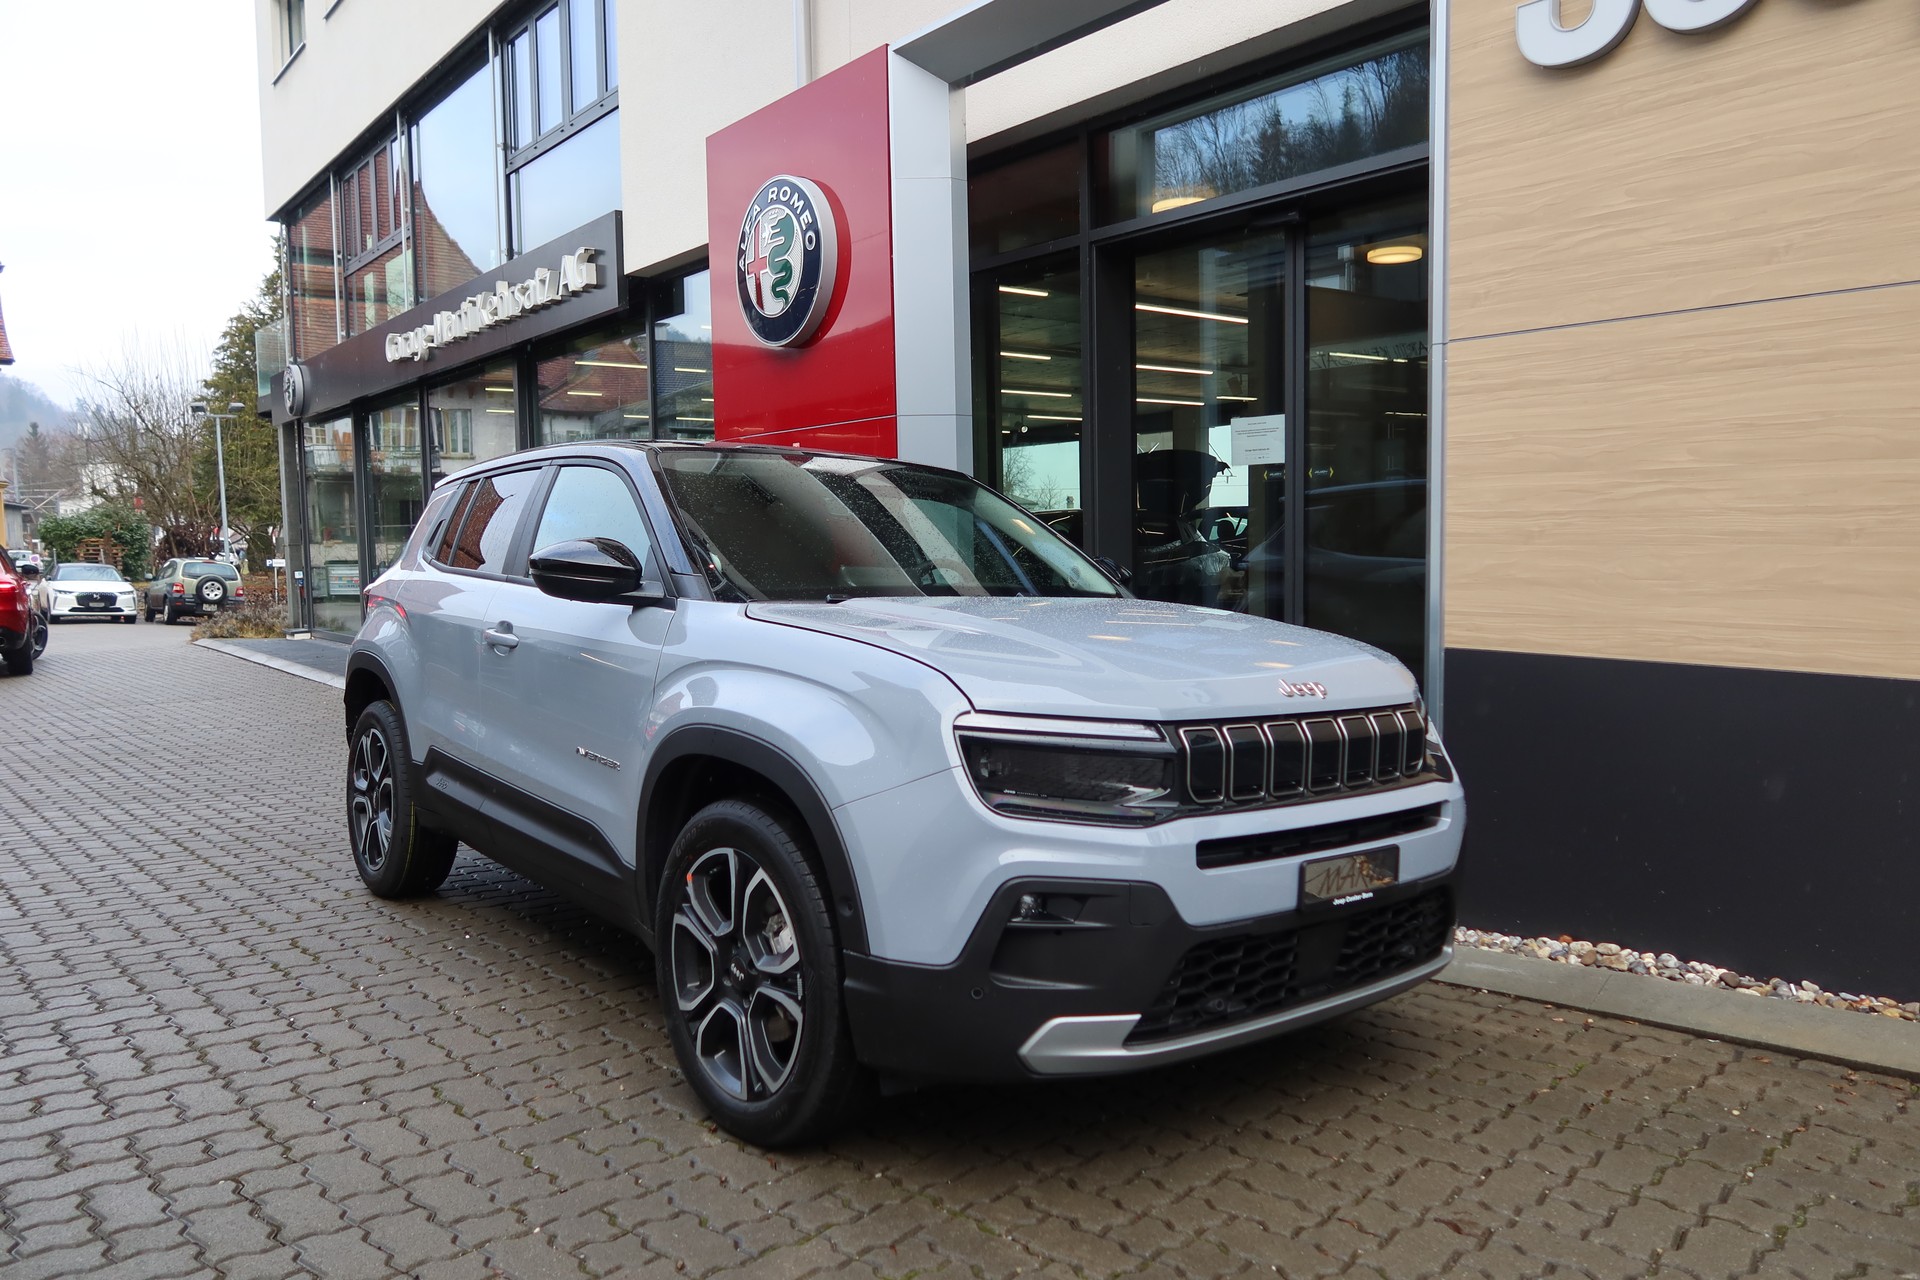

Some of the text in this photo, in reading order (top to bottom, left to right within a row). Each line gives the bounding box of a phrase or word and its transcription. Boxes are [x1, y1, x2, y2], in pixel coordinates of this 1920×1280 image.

[738, 186, 816, 272] ALFA ROMEO
[385, 324, 435, 362] Garage
[559, 247, 597, 296] AG
[266, 559, 273, 567] P
[1278, 678, 1328, 700] Jeep
[575, 746, 621, 772] AVENGER
